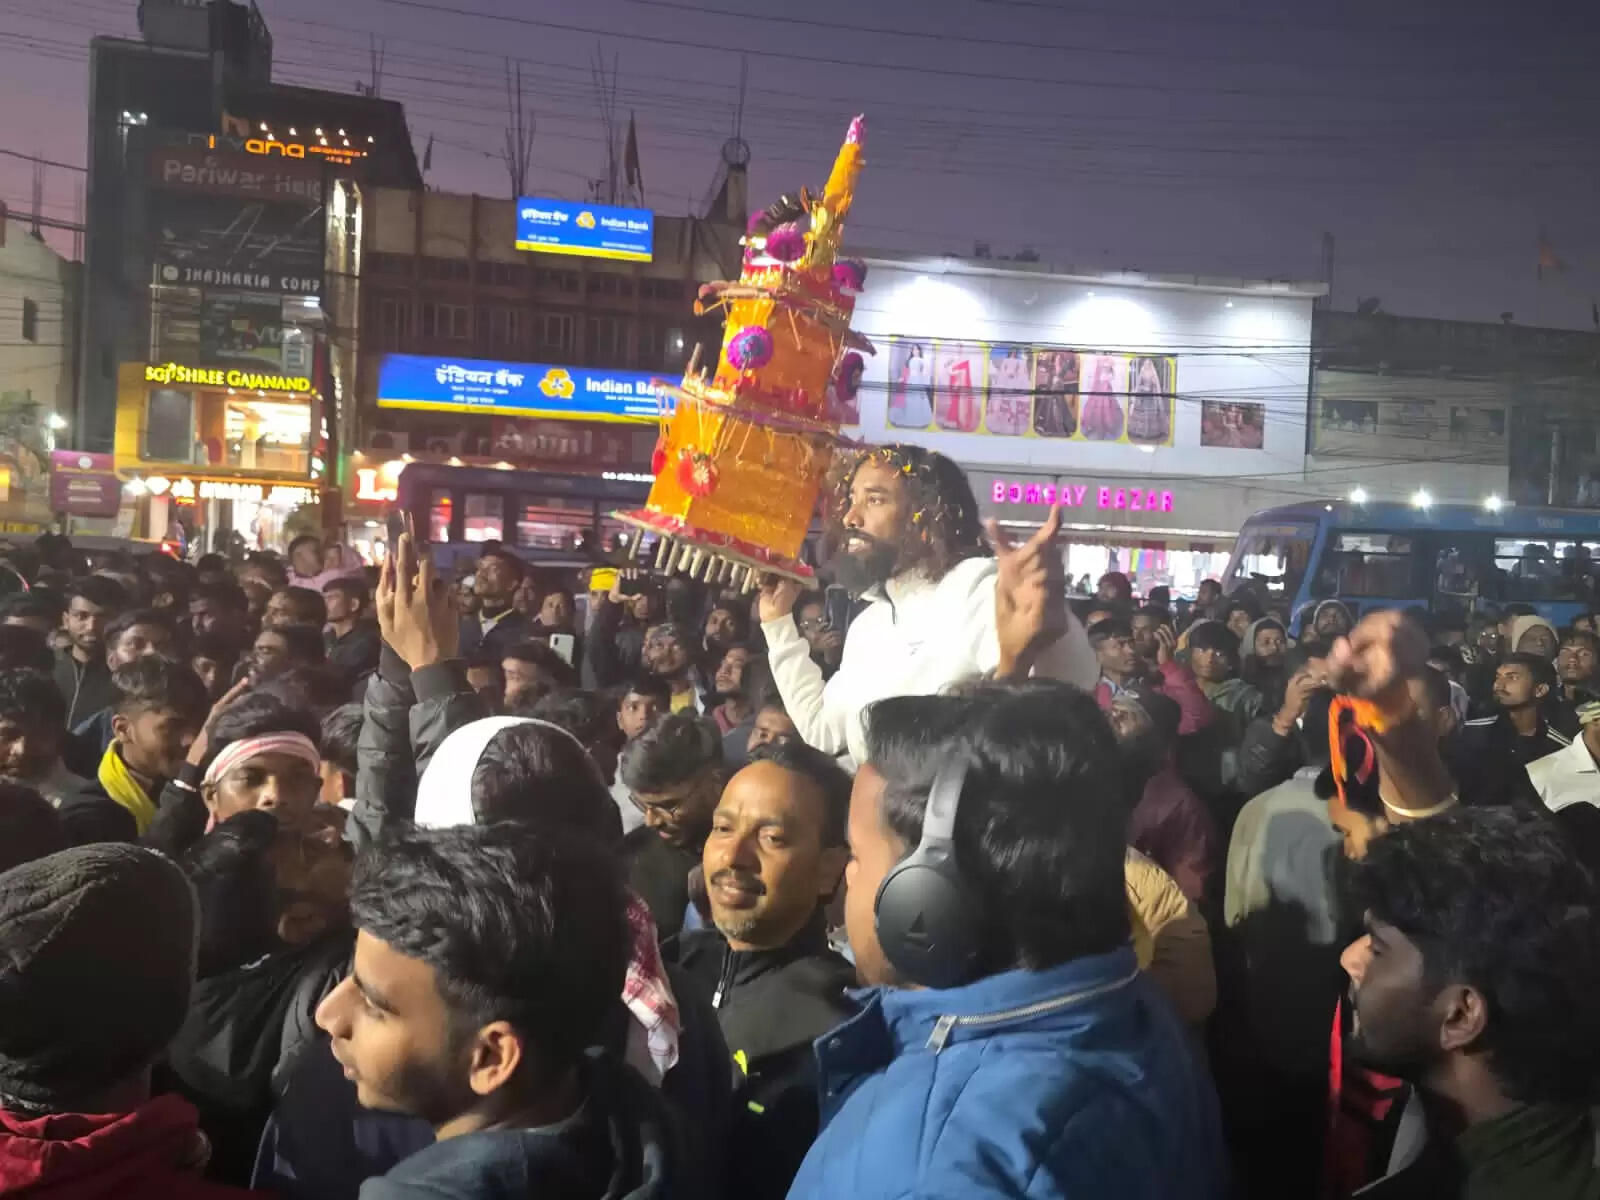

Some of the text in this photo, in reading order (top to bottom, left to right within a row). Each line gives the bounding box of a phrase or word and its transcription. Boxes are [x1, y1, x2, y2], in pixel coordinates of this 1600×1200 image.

[600, 216, 627, 229] Indian
[627, 219, 649, 231] Bank
[175, 365, 225, 385] SHREE
[226, 370, 311, 392] GAJANAND
[435, 364, 525, 387] इंडियन बैंक
[586, 376, 633, 394] Indian
[991, 479, 1176, 513] BOMBAY BAZAR
